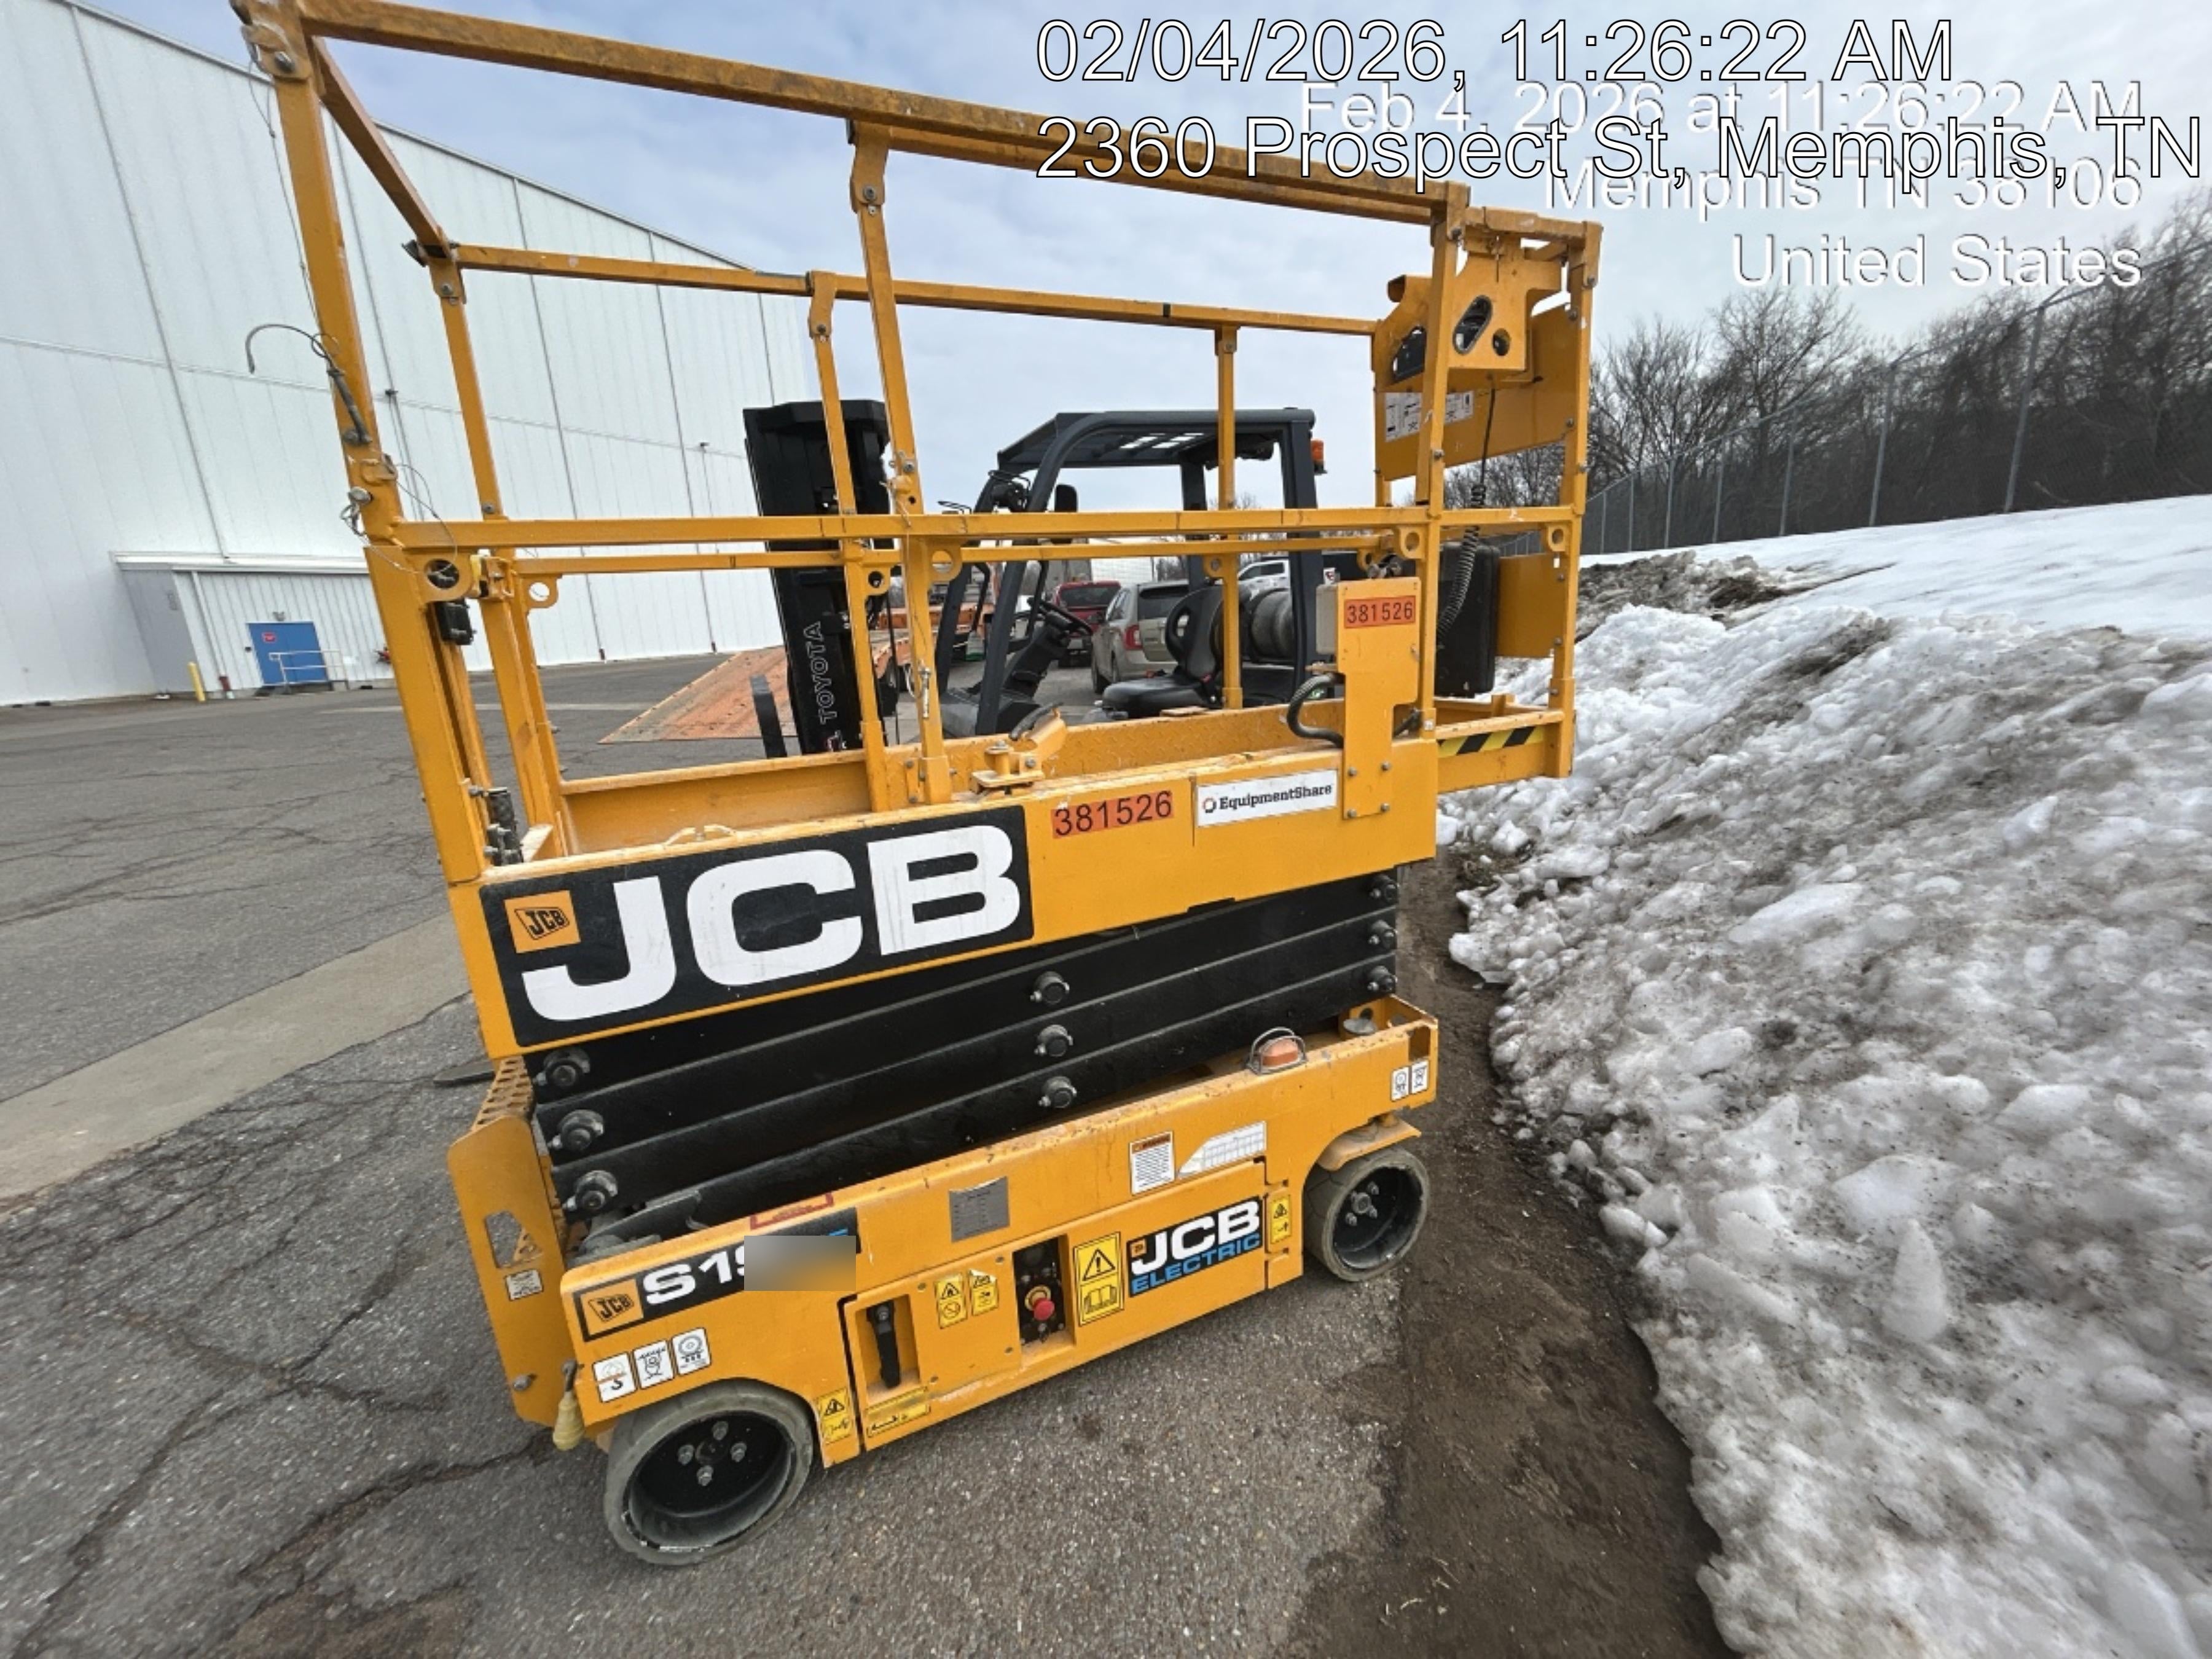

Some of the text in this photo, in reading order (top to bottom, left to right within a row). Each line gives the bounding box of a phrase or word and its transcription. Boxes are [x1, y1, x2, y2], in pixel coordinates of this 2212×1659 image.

[1347, 602, 1413, 624] 381526
[803, 621, 839, 725] TOYOTA
[1055, 790, 1171, 836] 381526
[1219, 785, 1332, 810] EquipmentShare
[522, 825, 1021, 1022] JCB
[525, 909, 565, 935] JCB
[1131, 1201, 1260, 1275] JCB
[1131, 1231, 1260, 1295] ELECTRIC
[597, 1294, 631, 1319] JCB
